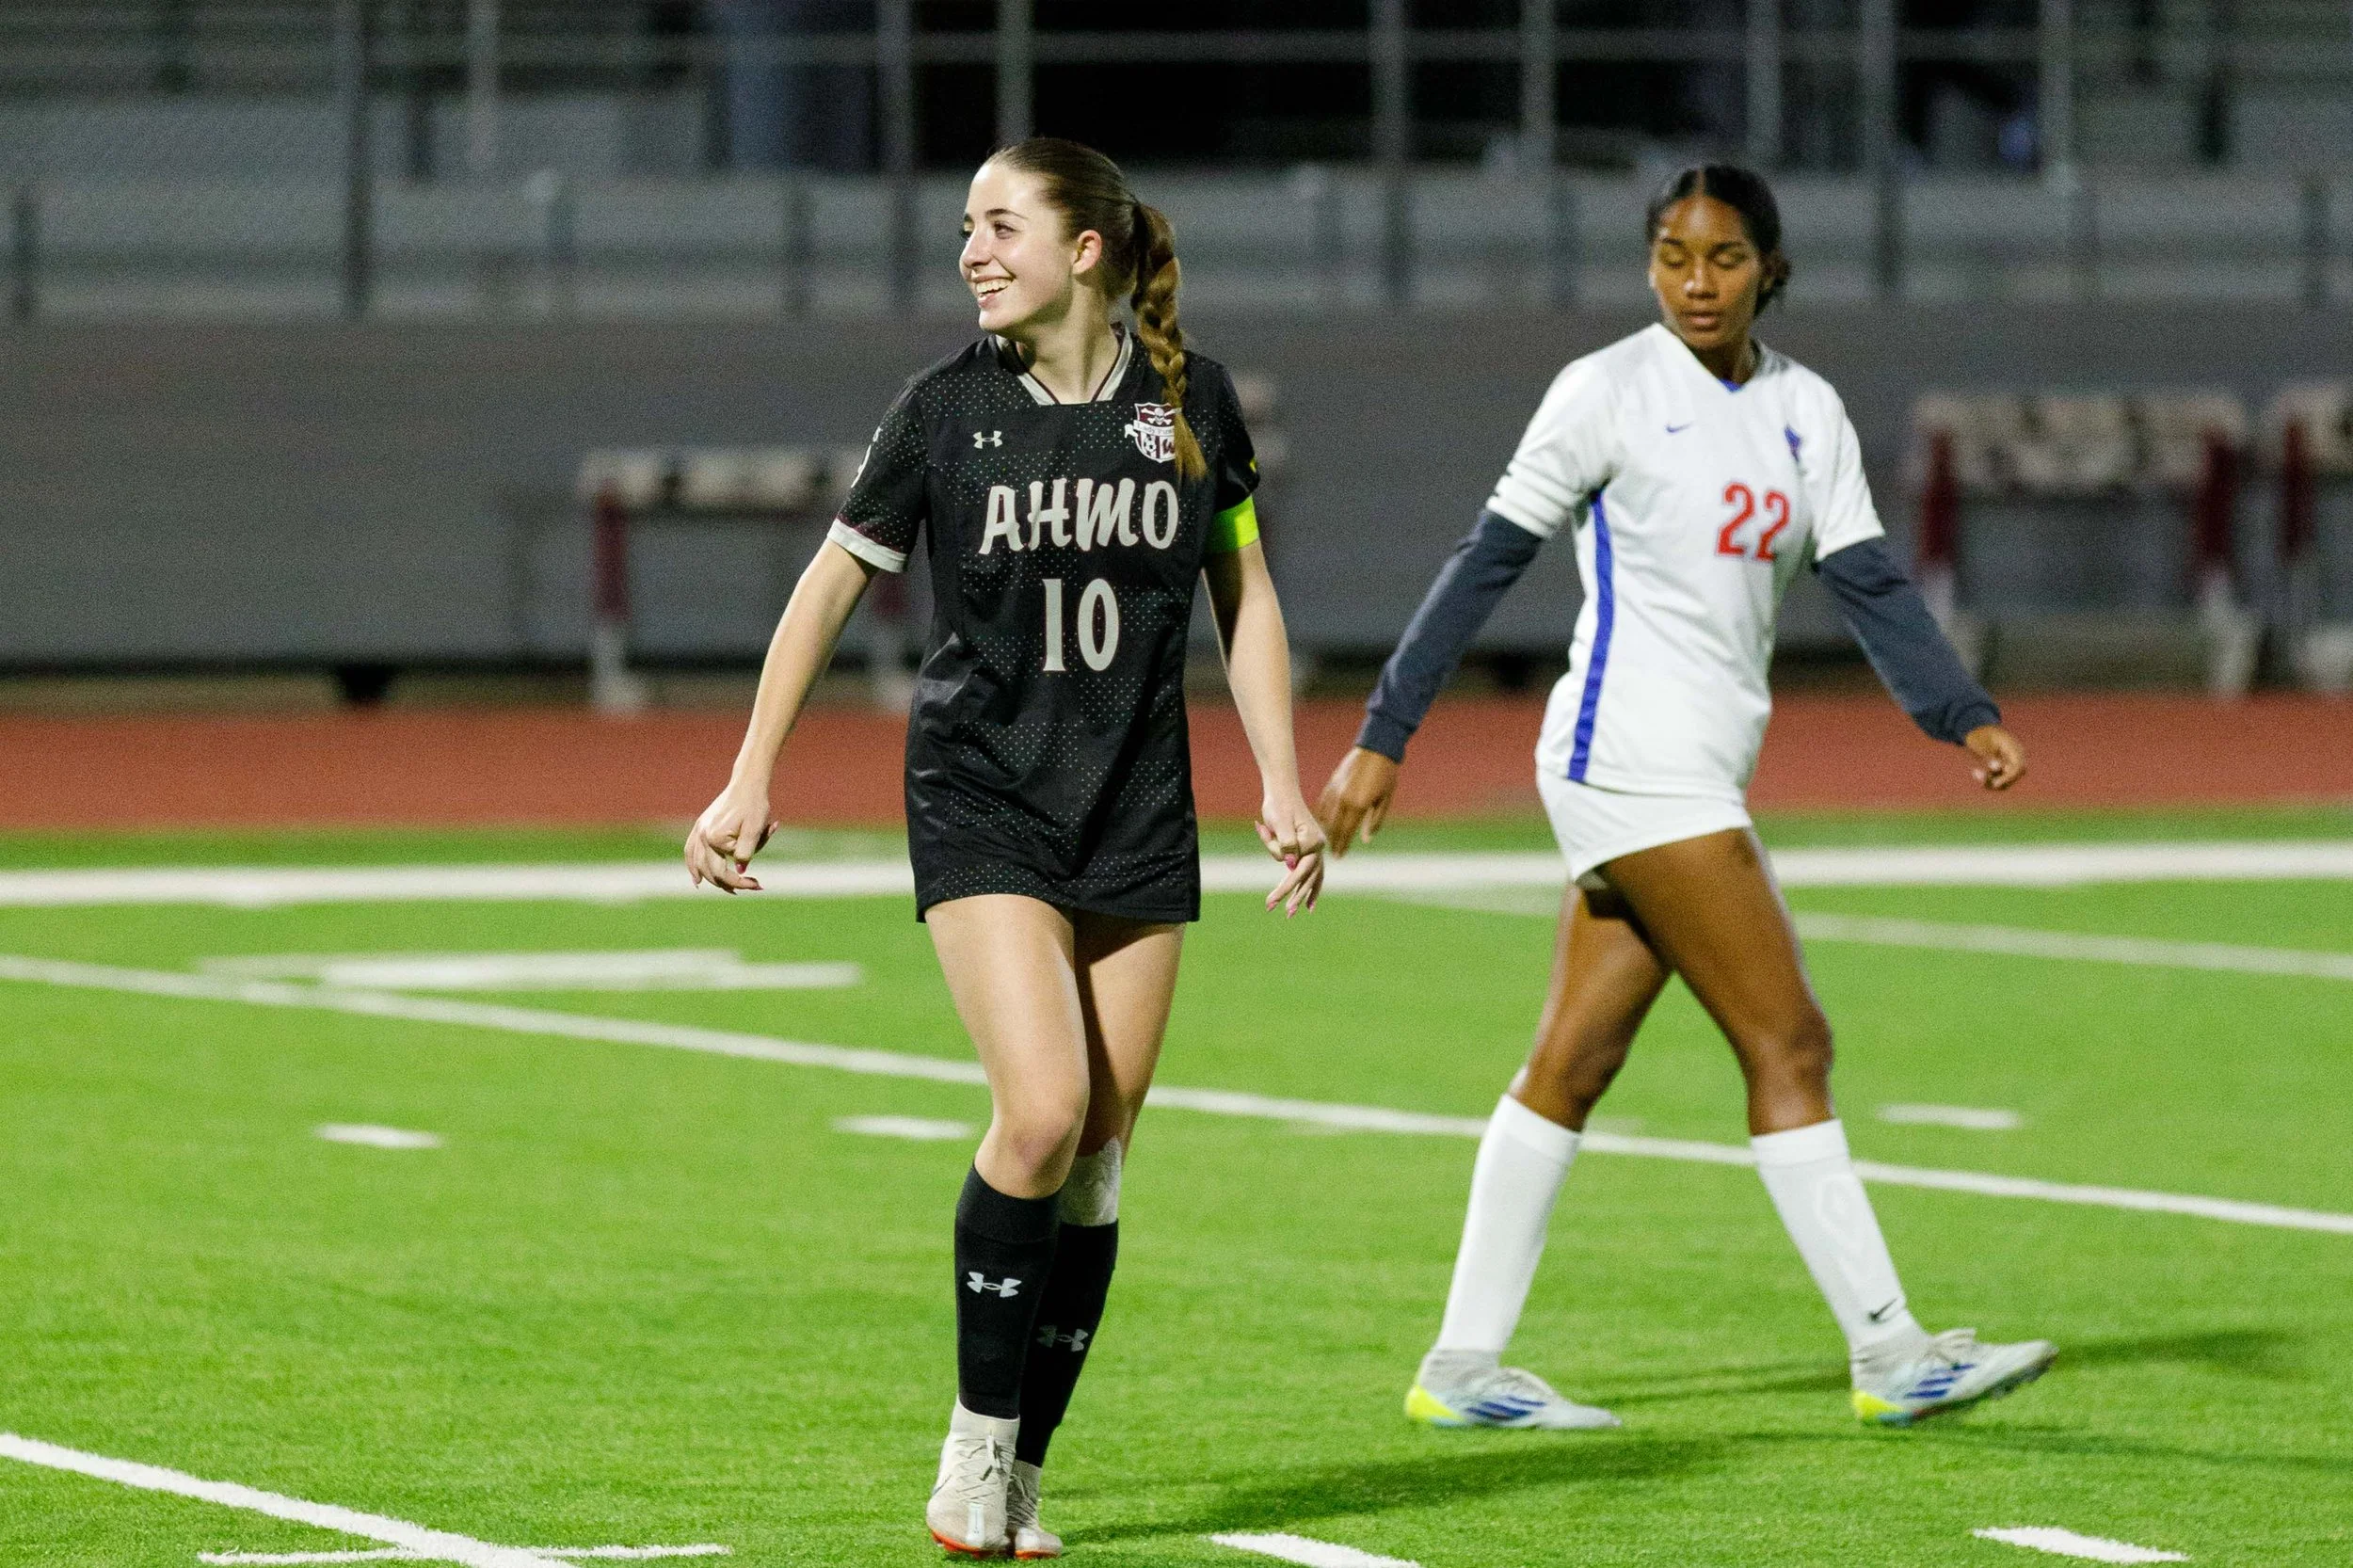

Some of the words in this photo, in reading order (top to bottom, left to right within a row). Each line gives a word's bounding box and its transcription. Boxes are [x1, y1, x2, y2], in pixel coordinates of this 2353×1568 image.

[979, 478, 1179, 555] AHMO
[1715, 482, 1790, 563] 22
[1042, 578, 1119, 672] 10
